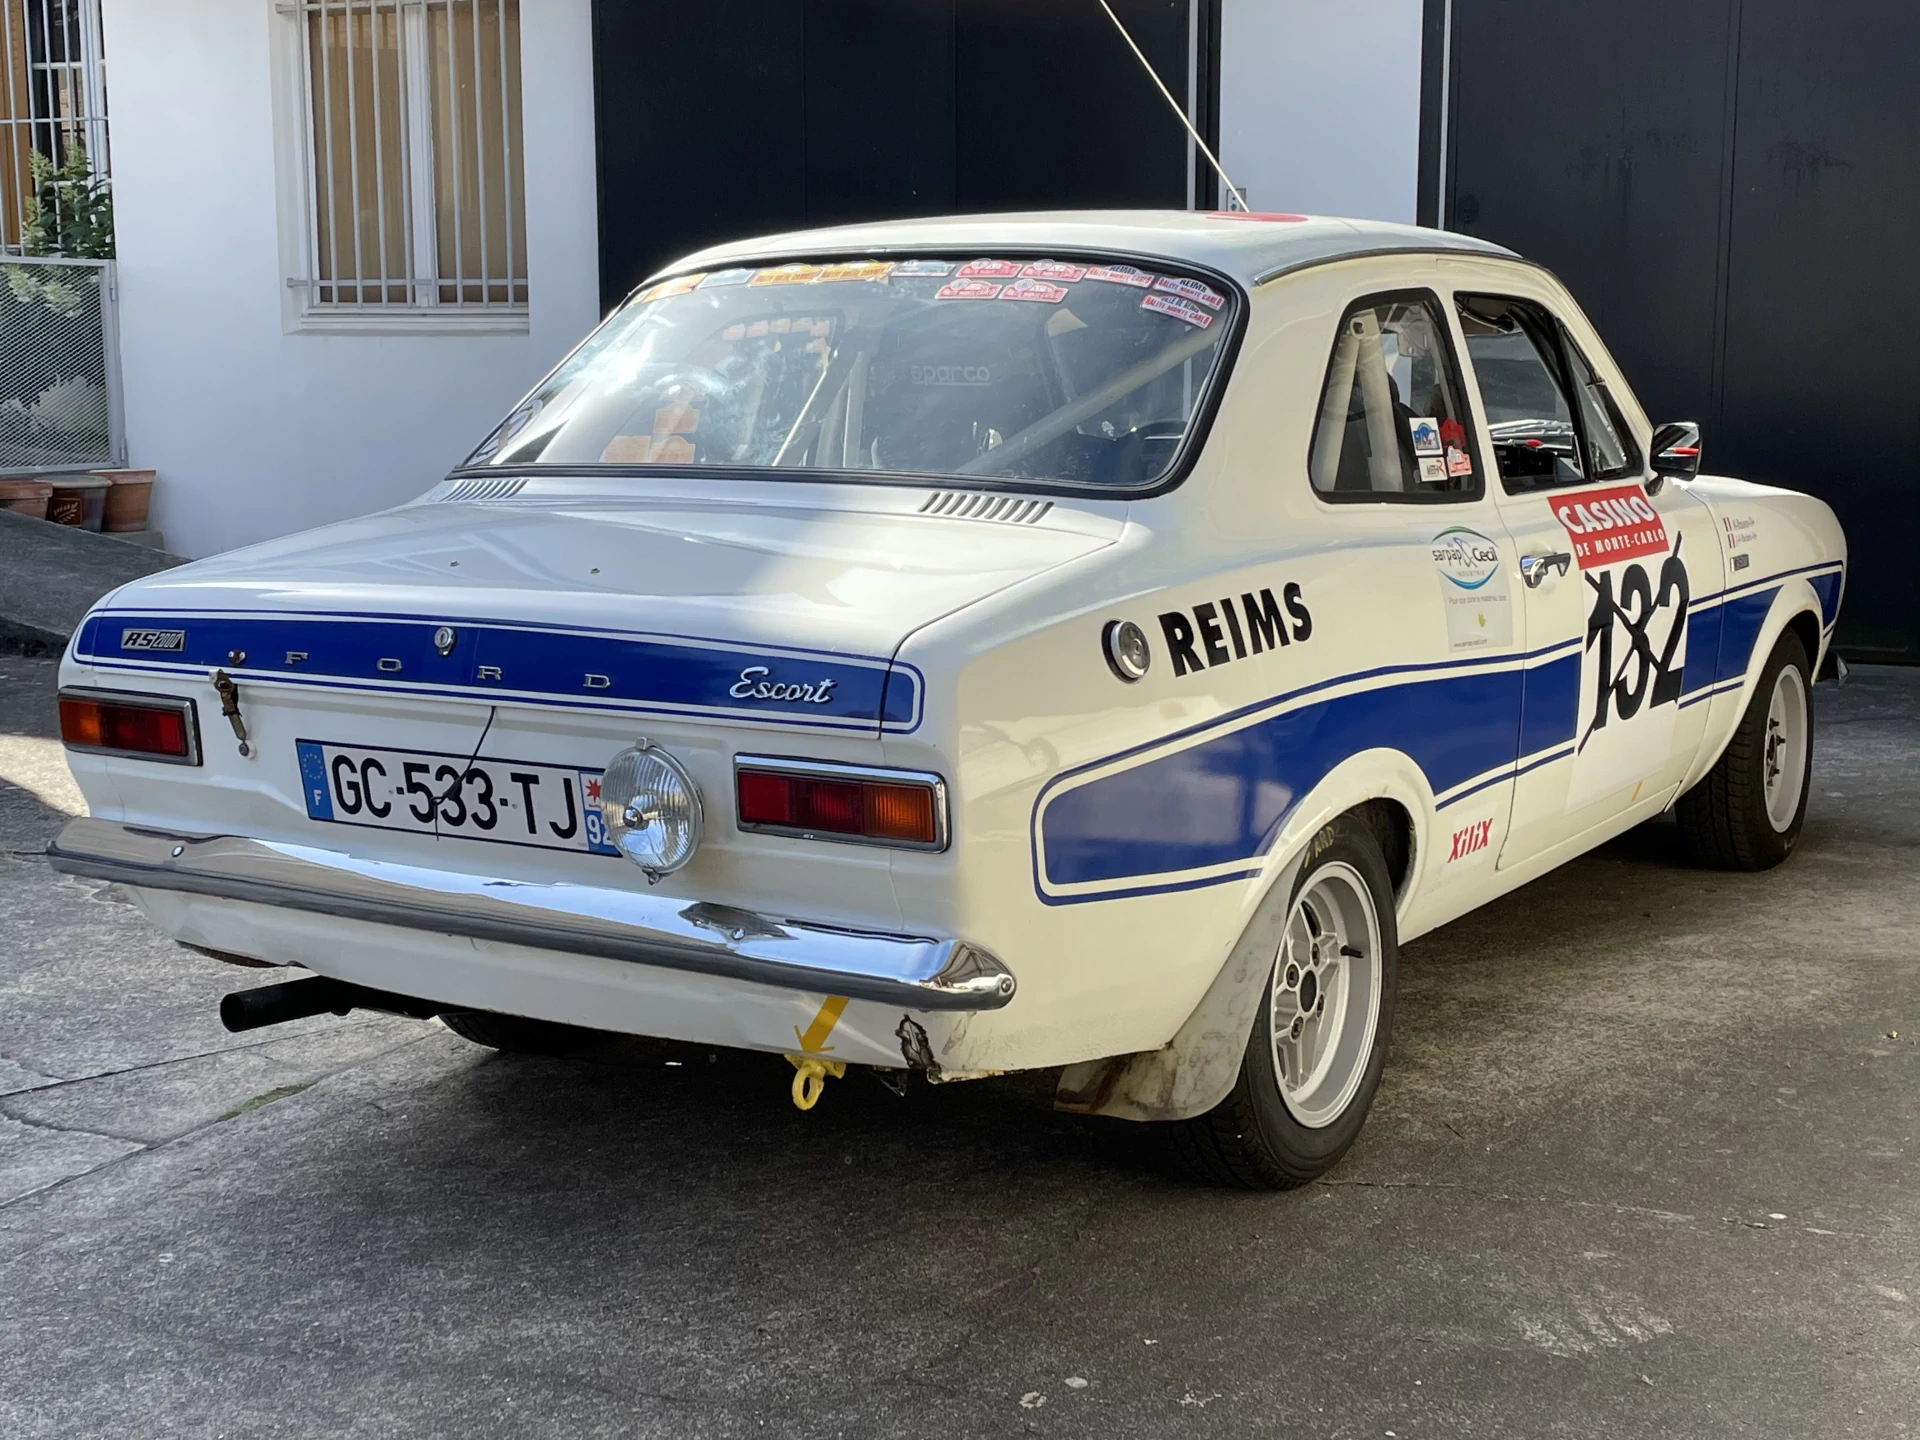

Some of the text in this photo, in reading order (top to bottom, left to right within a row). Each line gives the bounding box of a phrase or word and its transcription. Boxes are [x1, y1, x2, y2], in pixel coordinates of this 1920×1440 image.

[1180, 279, 1207, 293] REIMS
[1180, 286, 1202, 298] MONTE
[1202, 293, 1222, 306] CARLO
[1167, 305, 1189, 316] MONTE
[1189, 312, 1210, 325] CARLO
[1558, 495, 1656, 535] CASINO
[1432, 548, 1463, 567] sarpap
[1472, 546, 1499, 562] Cecil
[1576, 528, 1665, 557] DE MONTE-CARLO
[1156, 581, 1314, 679] REIMS
[1585, 555, 1690, 732] 132
[729, 666, 836, 703] Escort
[313, 789, 323, 806] F
[331, 754, 578, 840] GC-533-TJ
